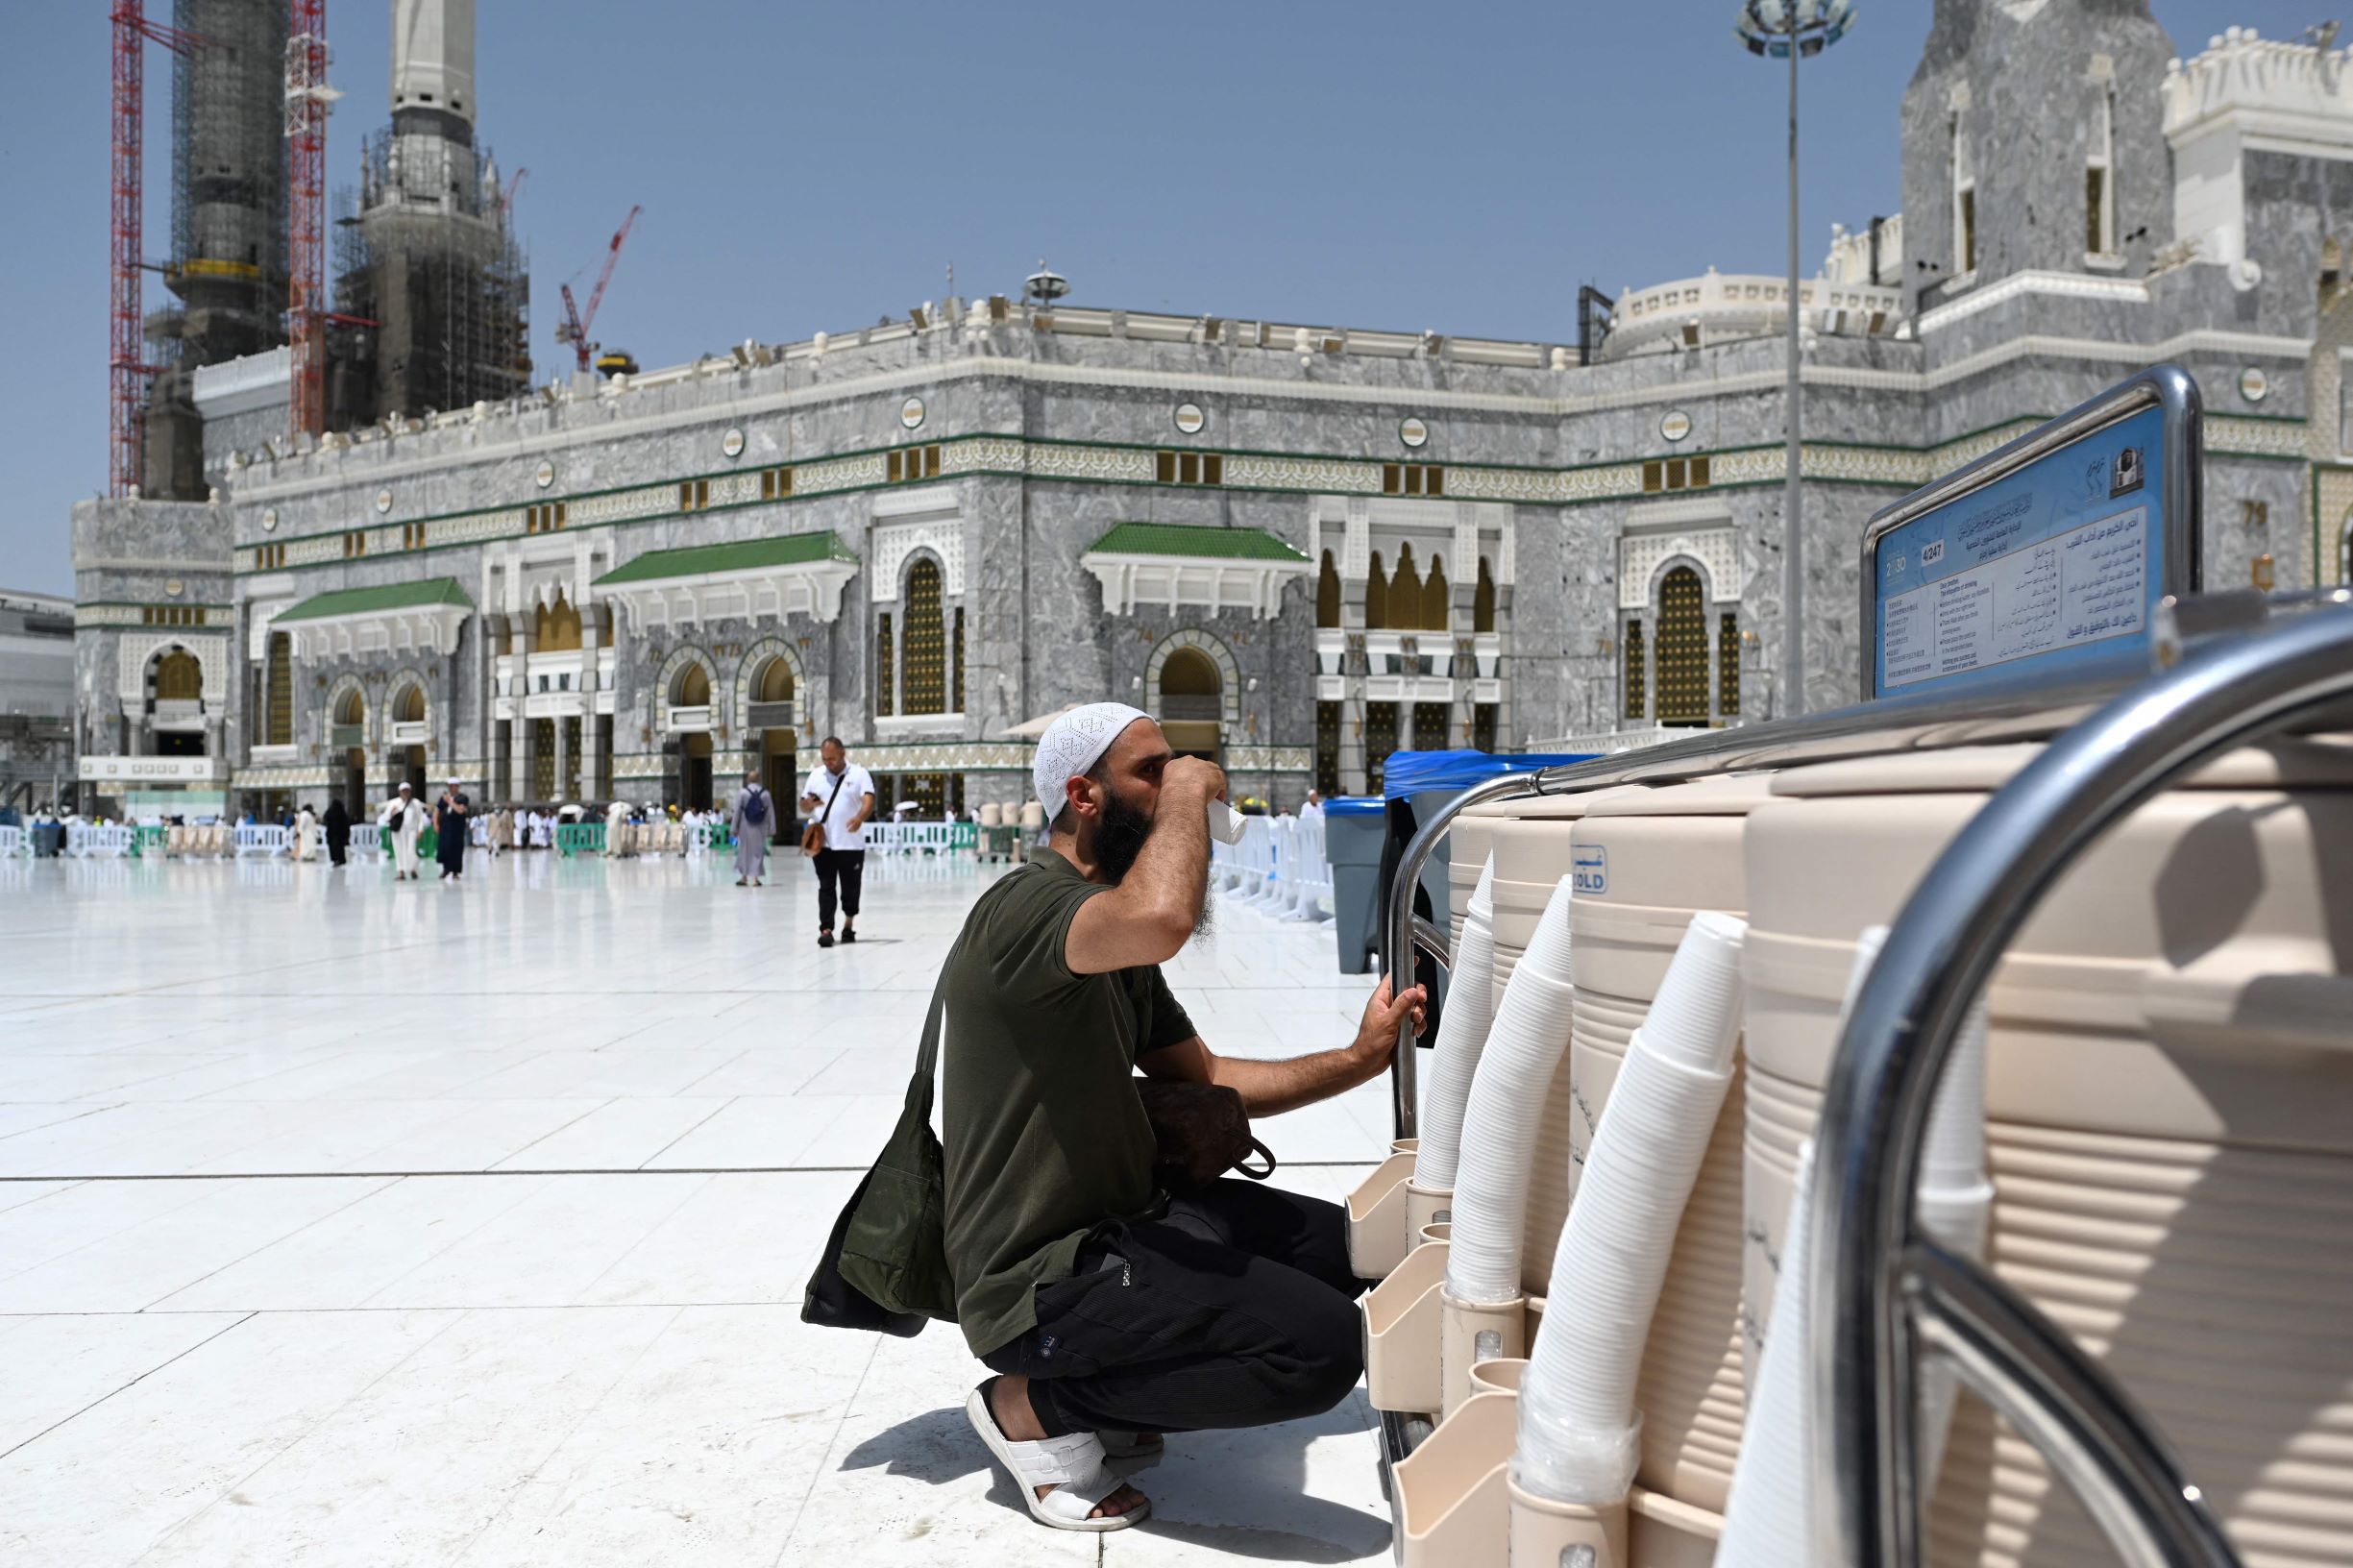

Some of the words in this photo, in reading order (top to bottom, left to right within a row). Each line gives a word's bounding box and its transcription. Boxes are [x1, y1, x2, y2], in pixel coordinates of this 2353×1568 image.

[1924, 545, 1941, 562] 4/247
[1138, 627, 1153, 643] 74
[1349, 653, 1364, 669] 75
[1458, 657, 1473, 674] 77
